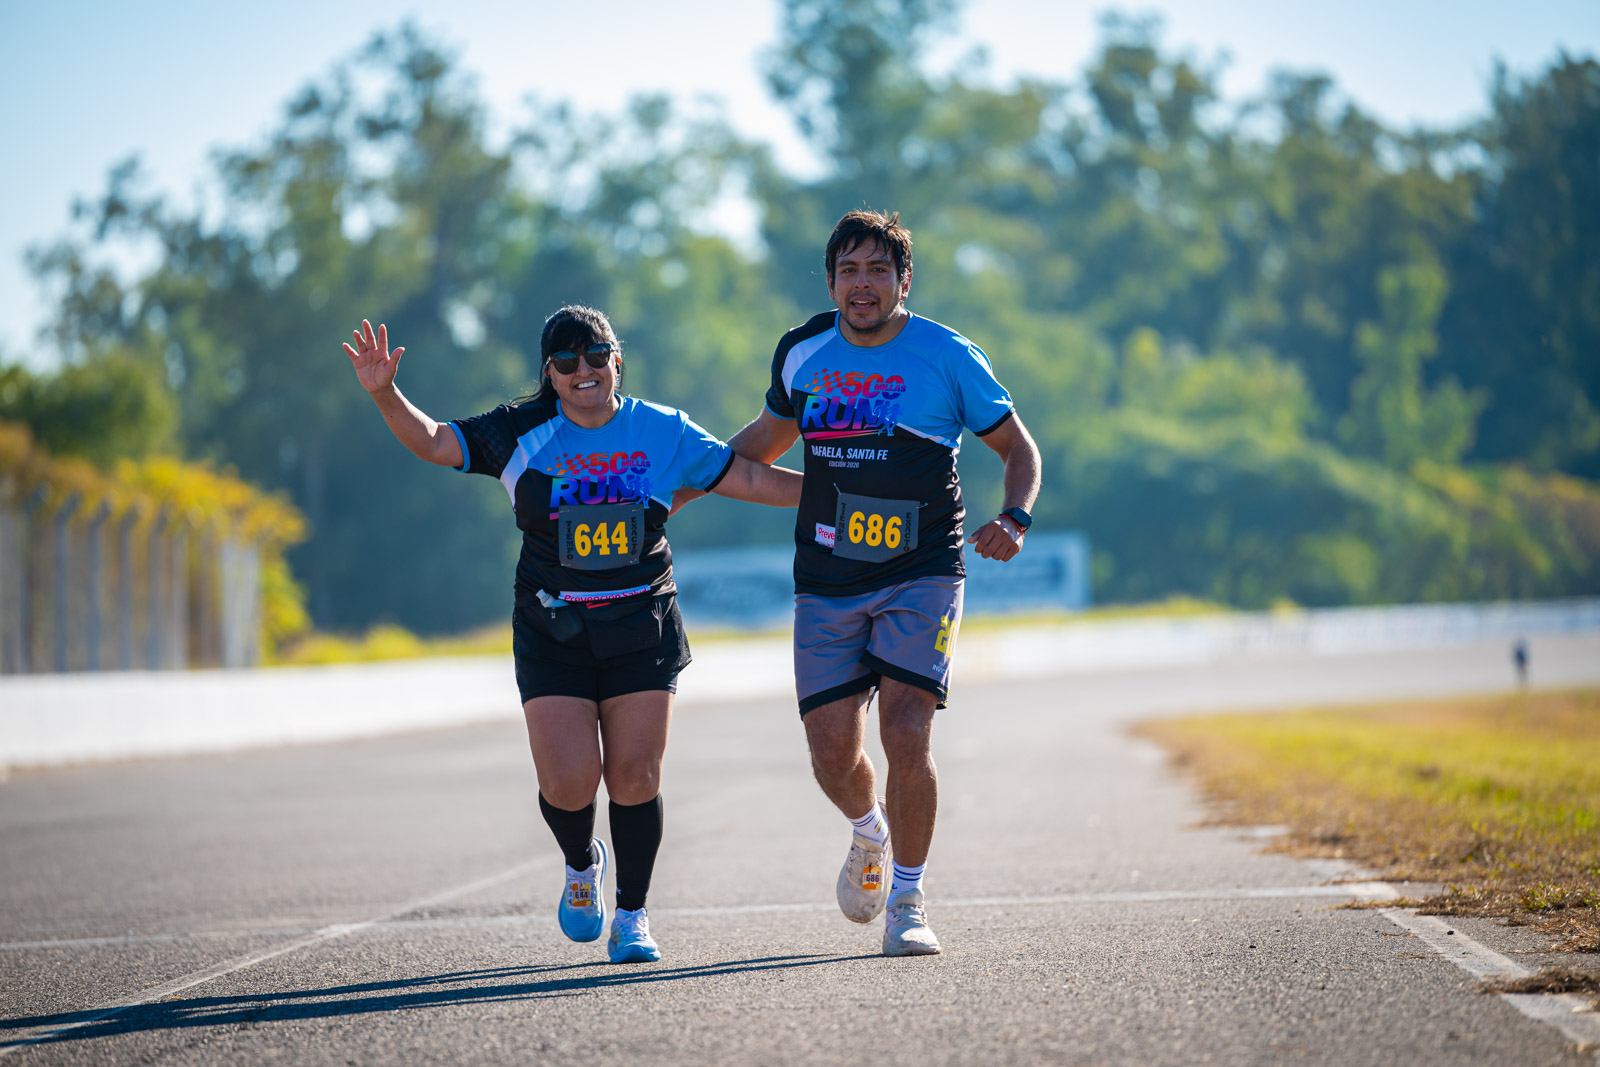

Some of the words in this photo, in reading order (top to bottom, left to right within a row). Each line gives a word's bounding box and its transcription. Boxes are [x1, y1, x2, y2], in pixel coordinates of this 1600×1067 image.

[874, 383, 907, 392] MILLAS
[811, 445, 844, 459] RAFAELA,
[846, 448, 875, 460] SANTA
[876, 449, 888, 460] FE
[565, 521, 574, 560] TIEMPO
[574, 521, 629, 557] 644
[630, 516, 638, 555] EXACTO
[837, 502, 847, 541] TIEMPO
[848, 511, 902, 549] 686
[903, 512, 912, 552] EXACTO
[866, 874, 880, 883] 686
